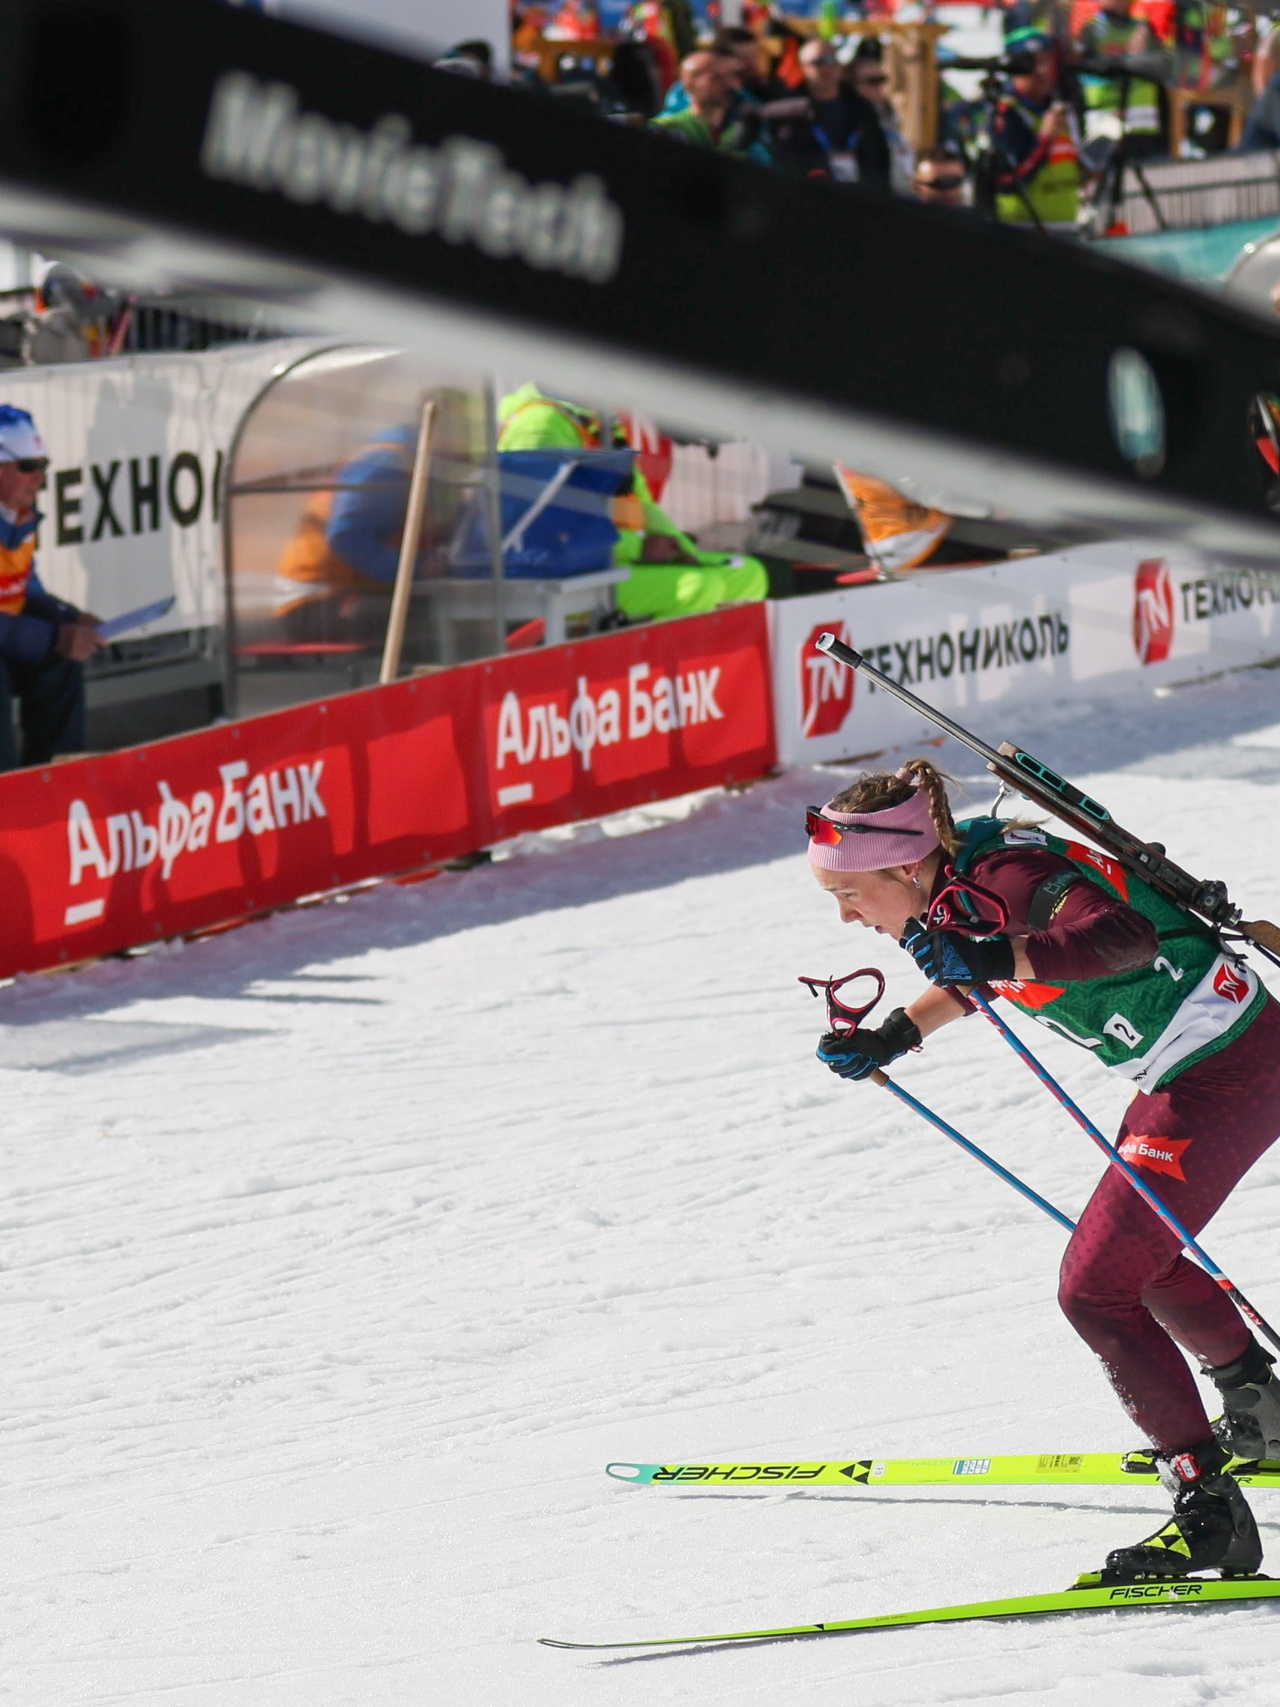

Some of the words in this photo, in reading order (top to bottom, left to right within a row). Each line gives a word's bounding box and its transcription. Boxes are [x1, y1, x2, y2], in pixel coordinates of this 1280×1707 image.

[44, 447, 222, 548] ЕХНО
[1154, 956, 1185, 982] 2
[1114, 1023, 1136, 1042] 2
[1138, 1143, 1174, 1162] Банк
[652, 1465, 827, 1480] FISCHER
[1109, 1585, 1203, 1600] FISCHER
